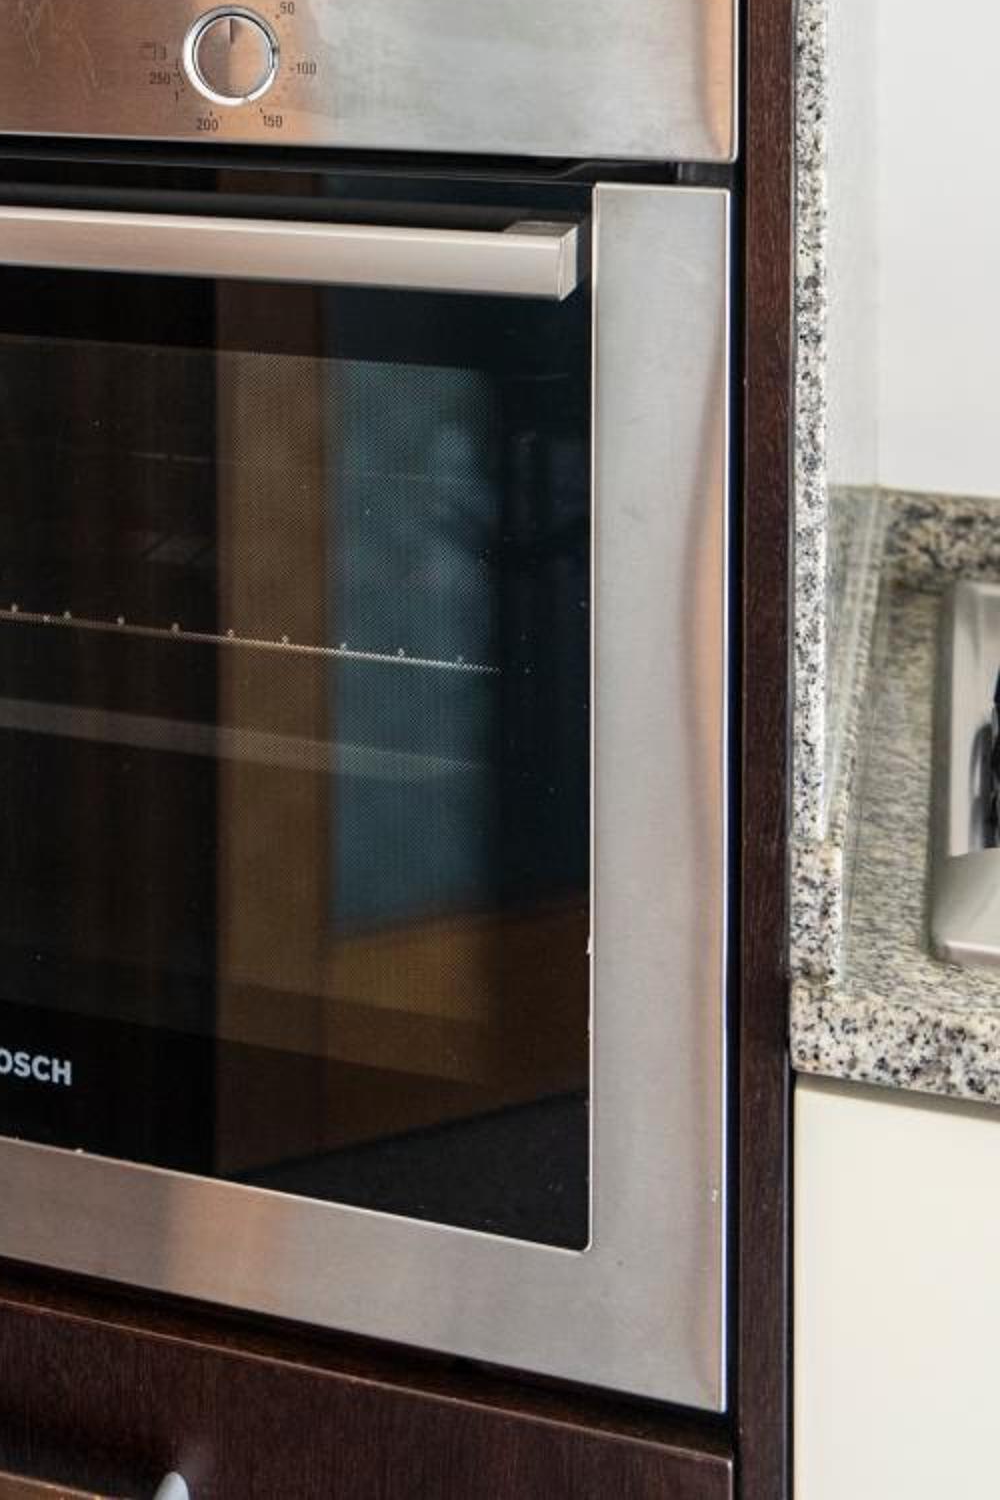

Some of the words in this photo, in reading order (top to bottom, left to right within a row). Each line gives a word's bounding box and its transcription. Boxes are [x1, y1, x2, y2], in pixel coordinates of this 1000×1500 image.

[279, 1, 296, 15] 50
[296, 62, 317, 76] 100
[149, 71, 171, 85] 250
[195, 117, 219, 132] 200
[262, 114, 283, 129] 150
